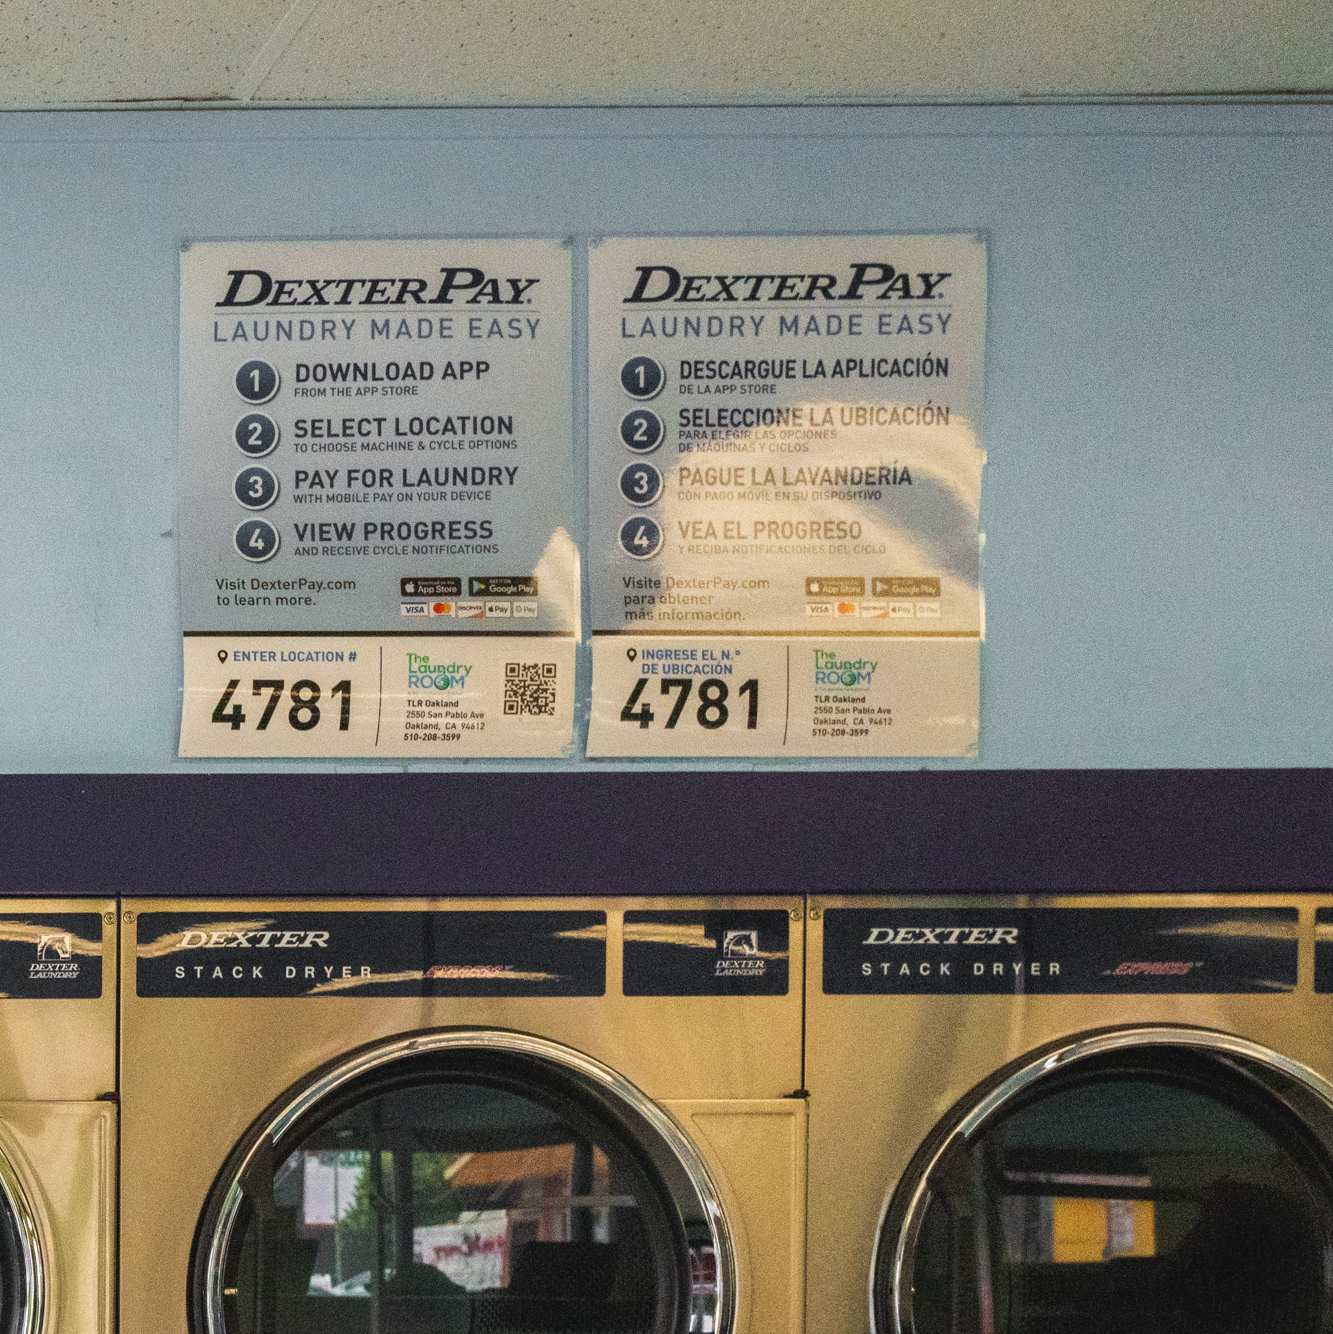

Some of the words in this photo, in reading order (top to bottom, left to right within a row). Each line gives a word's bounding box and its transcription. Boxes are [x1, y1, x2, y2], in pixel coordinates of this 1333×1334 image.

[213, 319, 356, 343] LAUNDRY
[370, 316, 453, 340] MADE
[468, 316, 541, 340] EASY
[621, 315, 765, 340] LAUNDRY
[779, 313, 862, 336] MADE
[878, 312, 952, 336] EASY
[295, 361, 435, 383] DOWNLOAD
[441, 359, 491, 380] APP
[634, 365, 645, 388] 1
[678, 358, 797, 381] DESCARGUE
[802, 359, 827, 380] LA
[830, 351, 949, 379] APLICACIÓN
[248, 368, 260, 392] 1
[293, 387, 327, 398] FROM
[330, 386, 352, 398] THE
[355, 386, 379, 396] APP
[381, 384, 417, 397] STORE
[678, 384, 692, 394] DE
[697, 384, 712, 396] LA
[714, 383, 737, 394] APP
[740, 383, 775, 396] STORE
[678, 407, 803, 429] SELECCIONE
[810, 407, 835, 428] LA
[839, 400, 952, 428] UBICACIÓN
[247, 421, 263, 446] 2
[294, 417, 387, 440] SELECT
[394, 414, 513, 437] LOCATION
[633, 418, 649, 441] 2
[292, 442, 309, 453] TO
[310, 442, 357, 453] CHOOSE
[360, 441, 413, 453] MACHINE
[417, 440, 426, 451] &
[428, 438, 464, 451] CYCLE
[468, 438, 519, 450] OPTIONS
[294, 469, 339, 490] PAY
[346, 468, 394, 489] FOR
[402, 466, 520, 488] LAUNDRY
[634, 470, 649, 495] 3
[677, 466, 745, 488] PAGUE
[751, 467, 777, 488] LA
[782, 460, 914, 488] LAVANDERÍA
[247, 474, 264, 499] 3
[292, 493, 323, 505] WITH
[325, 492, 369, 504] MOBILE
[372, 492, 394, 502] PAY
[396, 492, 414, 502] ON
[416, 490, 448, 502] YOUR
[450, 490, 492, 502] DEVICE
[248, 527, 265, 551] 4
[292, 522, 356, 543] VIEW
[363, 519, 494, 541] PROGRESS
[632, 524, 650, 548] 4
[677, 519, 718, 541] VEA
[723, 520, 747, 541] EL
[753, 519, 862, 541] PROGRESO
[293, 546, 319, 557] AND
[321, 545, 369, 557] RECEIVE
[372, 545, 407, 556] CYCLE
[411, 543, 500, 555] NOTIFICATIONS
[214, 578, 246, 591] Visit
[250, 576, 358, 593] DexterPay.com
[417, 585, 435, 595] App
[435, 585, 458, 593] Store
[216, 595, 230, 607] to
[234, 593, 272, 607] learn
[275, 596, 316, 607] more.
[232, 650, 277, 662] ENTER
[280, 650, 344, 662] LOCATION
[348, 650, 357, 662] #
[405, 652, 431, 665] The
[701, 648, 718, 662] EL
[408, 662, 474, 677] Laundry
[640, 663, 658, 676] DE
[662, 660, 733, 675] UBICACIÓN
[211, 678, 353, 733] 4781
[620, 676, 760, 731] 4781
[173, 928, 330, 951] DEXTER
[863, 927, 1019, 945] DEXTER
[175, 964, 263, 979] STACK
[285, 964, 375, 981] DRYER
[862, 961, 950, 976] STACK
[973, 961, 1060, 976] DRYER
